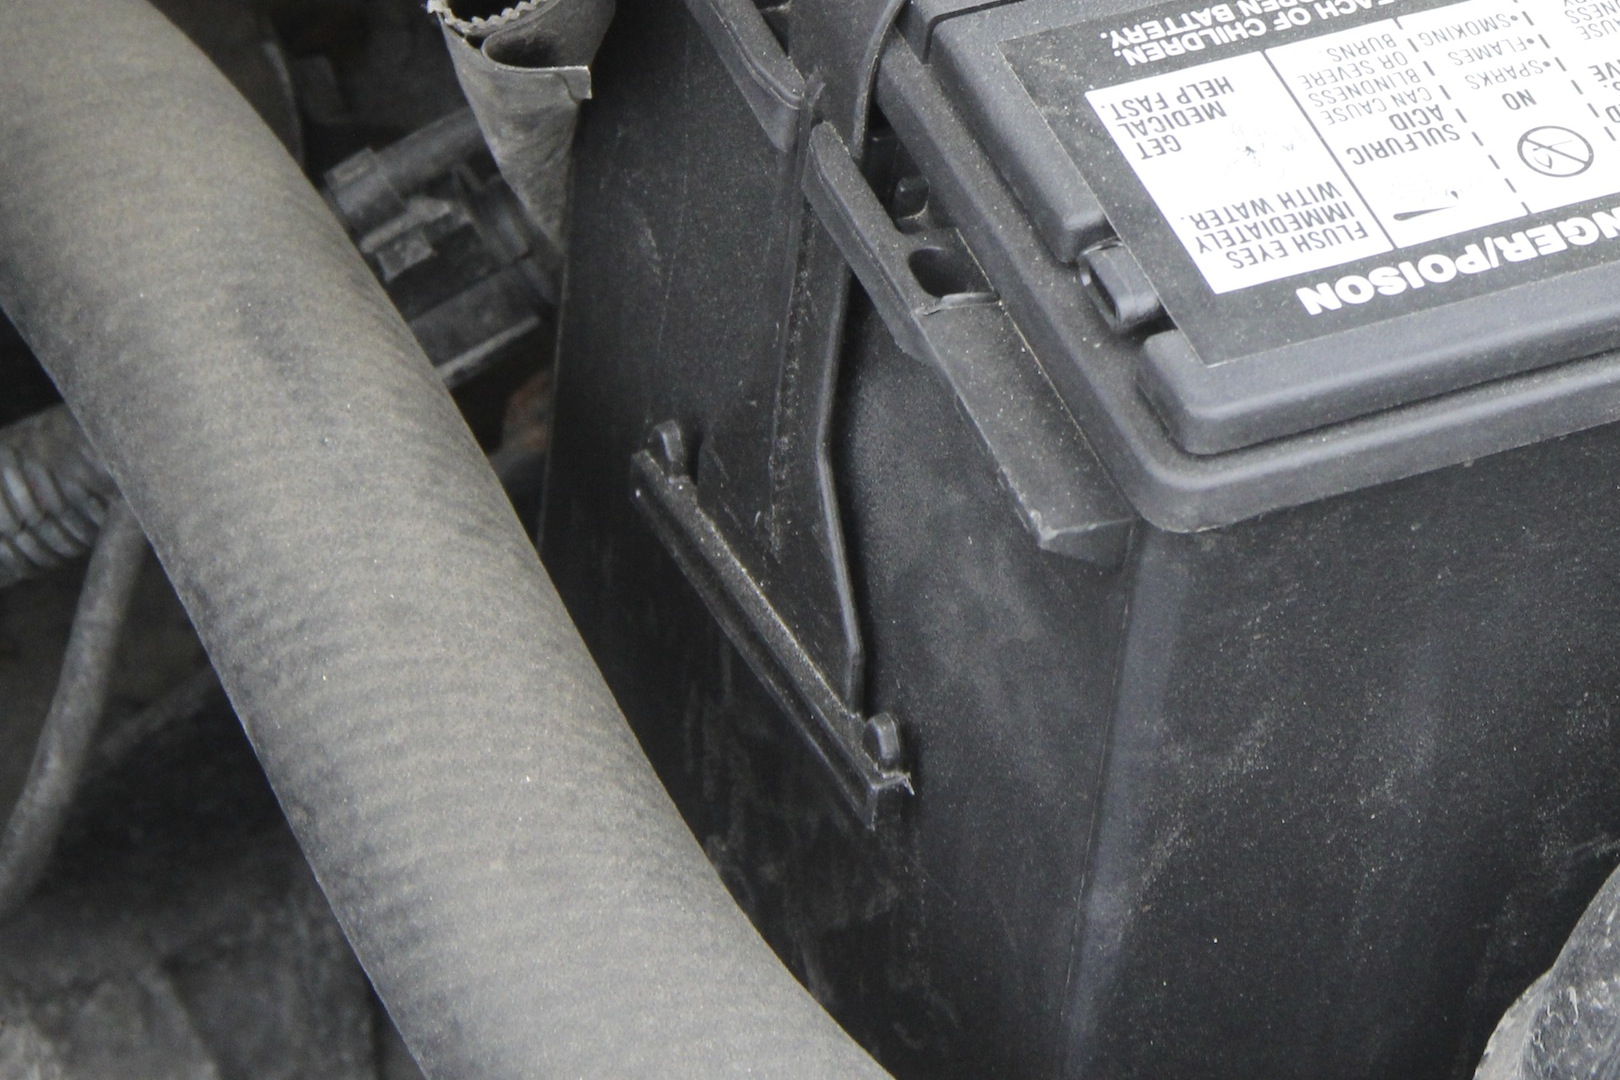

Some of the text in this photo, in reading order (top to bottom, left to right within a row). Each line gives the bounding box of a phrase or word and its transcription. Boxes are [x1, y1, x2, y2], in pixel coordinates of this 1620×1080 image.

[1100, 3, 1236, 49] BATTERY.
[1273, 7, 1311, 31] OF
[1418, 14, 1511, 46] SMOKING
[1114, 18, 1267, 66] CHILDREN.
[1448, 37, 1527, 66] FLAMES
[1299, 51, 1408, 89] OR SEVERE
[1308, 68, 1421, 107] BLINDNESS
[1465, 60, 1544, 89] SPARKS
[1101, 76, 1234, 120] HELP FAST.
[1321, 87, 1432, 125] CAN CAUSE
[1502, 89, 1537, 110] NO
[1117, 101, 1227, 139] MEDICAL
[1388, 104, 1444, 131] ACID
[1136, 134, 1182, 160] GET
[1346, 124, 1460, 165] SULFURIC
[1181, 181, 1342, 230] WITH WATER.
[1195, 201, 1355, 254] IMMEDIATELY
[1226, 221, 1369, 269] FLUSH EYES
